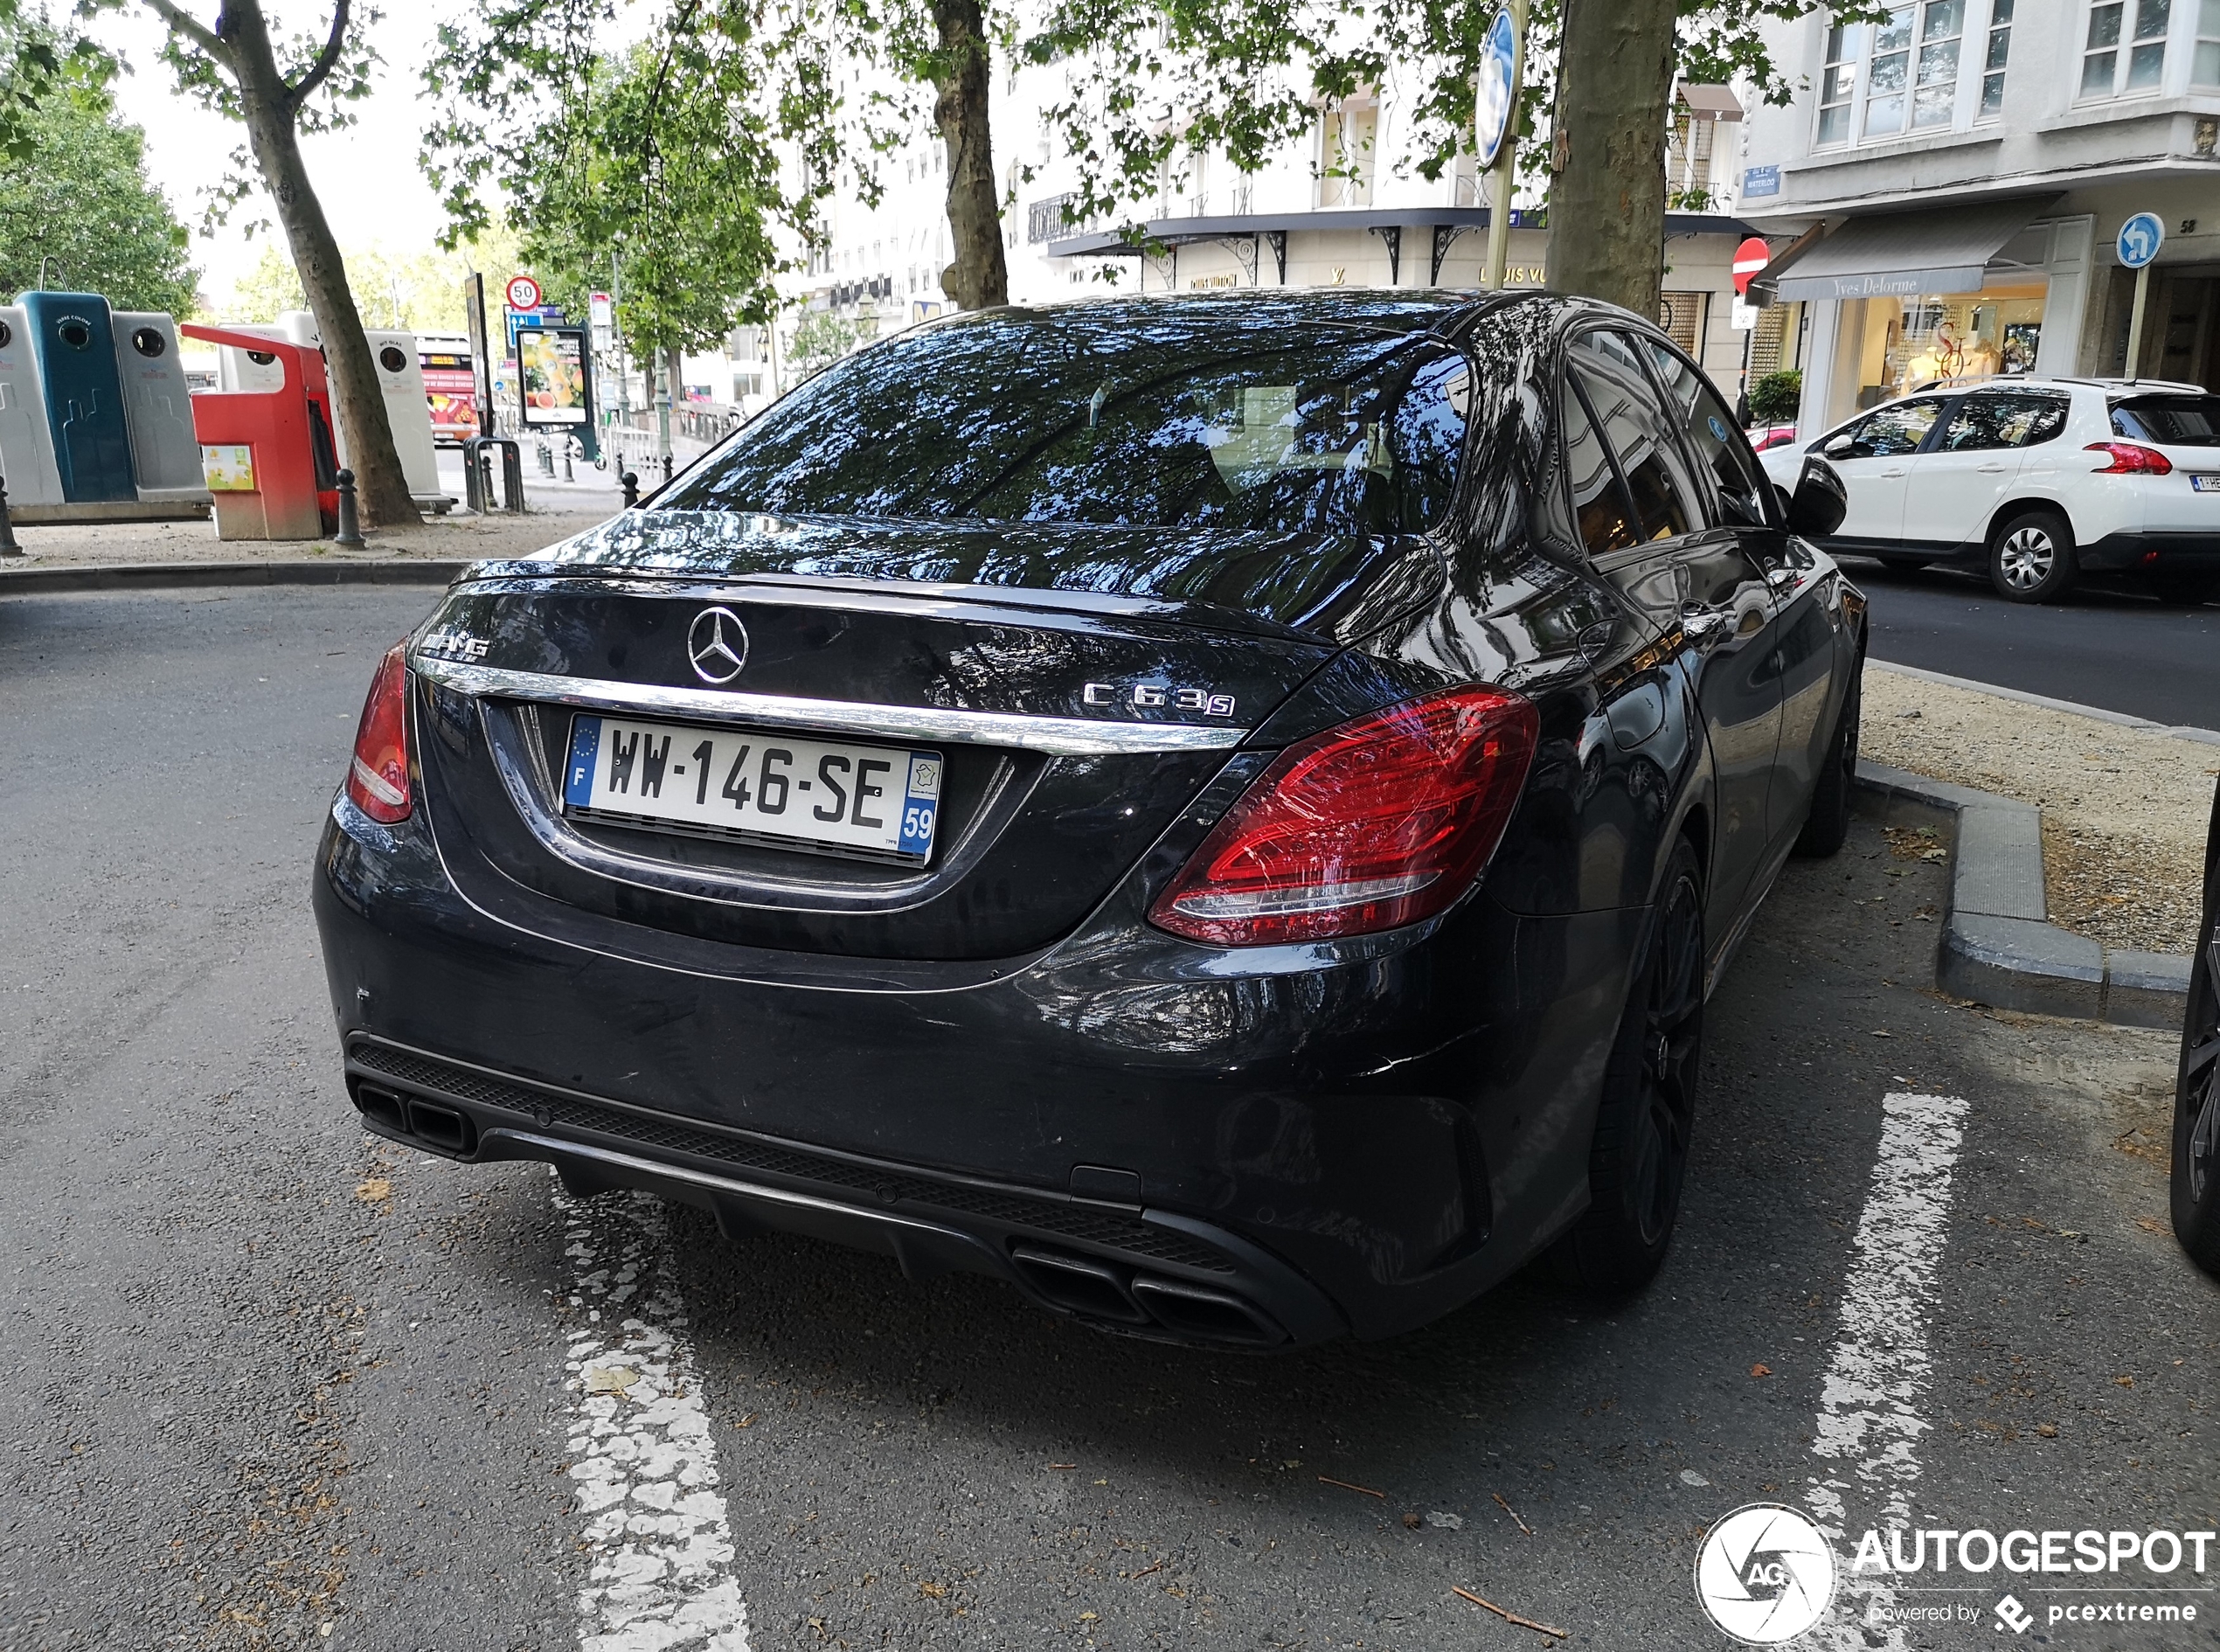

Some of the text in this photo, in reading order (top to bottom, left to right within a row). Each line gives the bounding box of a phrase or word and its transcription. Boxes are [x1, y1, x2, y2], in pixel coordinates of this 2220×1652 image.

[1747, 177, 1775, 189] WATERLOO
[2180, 219, 2196, 233] 58
[1209, 274, 1238, 288] VUITTON
[1479, 267, 1523, 283] LUIS
[514, 286, 532, 298] 50
[1834, 277, 1917, 296] Yves Delorme
[56, 315, 70, 324] VERRE
[432, 630, 489, 656] AMG
[1083, 683, 1114, 707] C
[573, 767, 585, 786] F
[608, 729, 891, 829] WW-146-SE
[904, 807, 933, 839] 59
